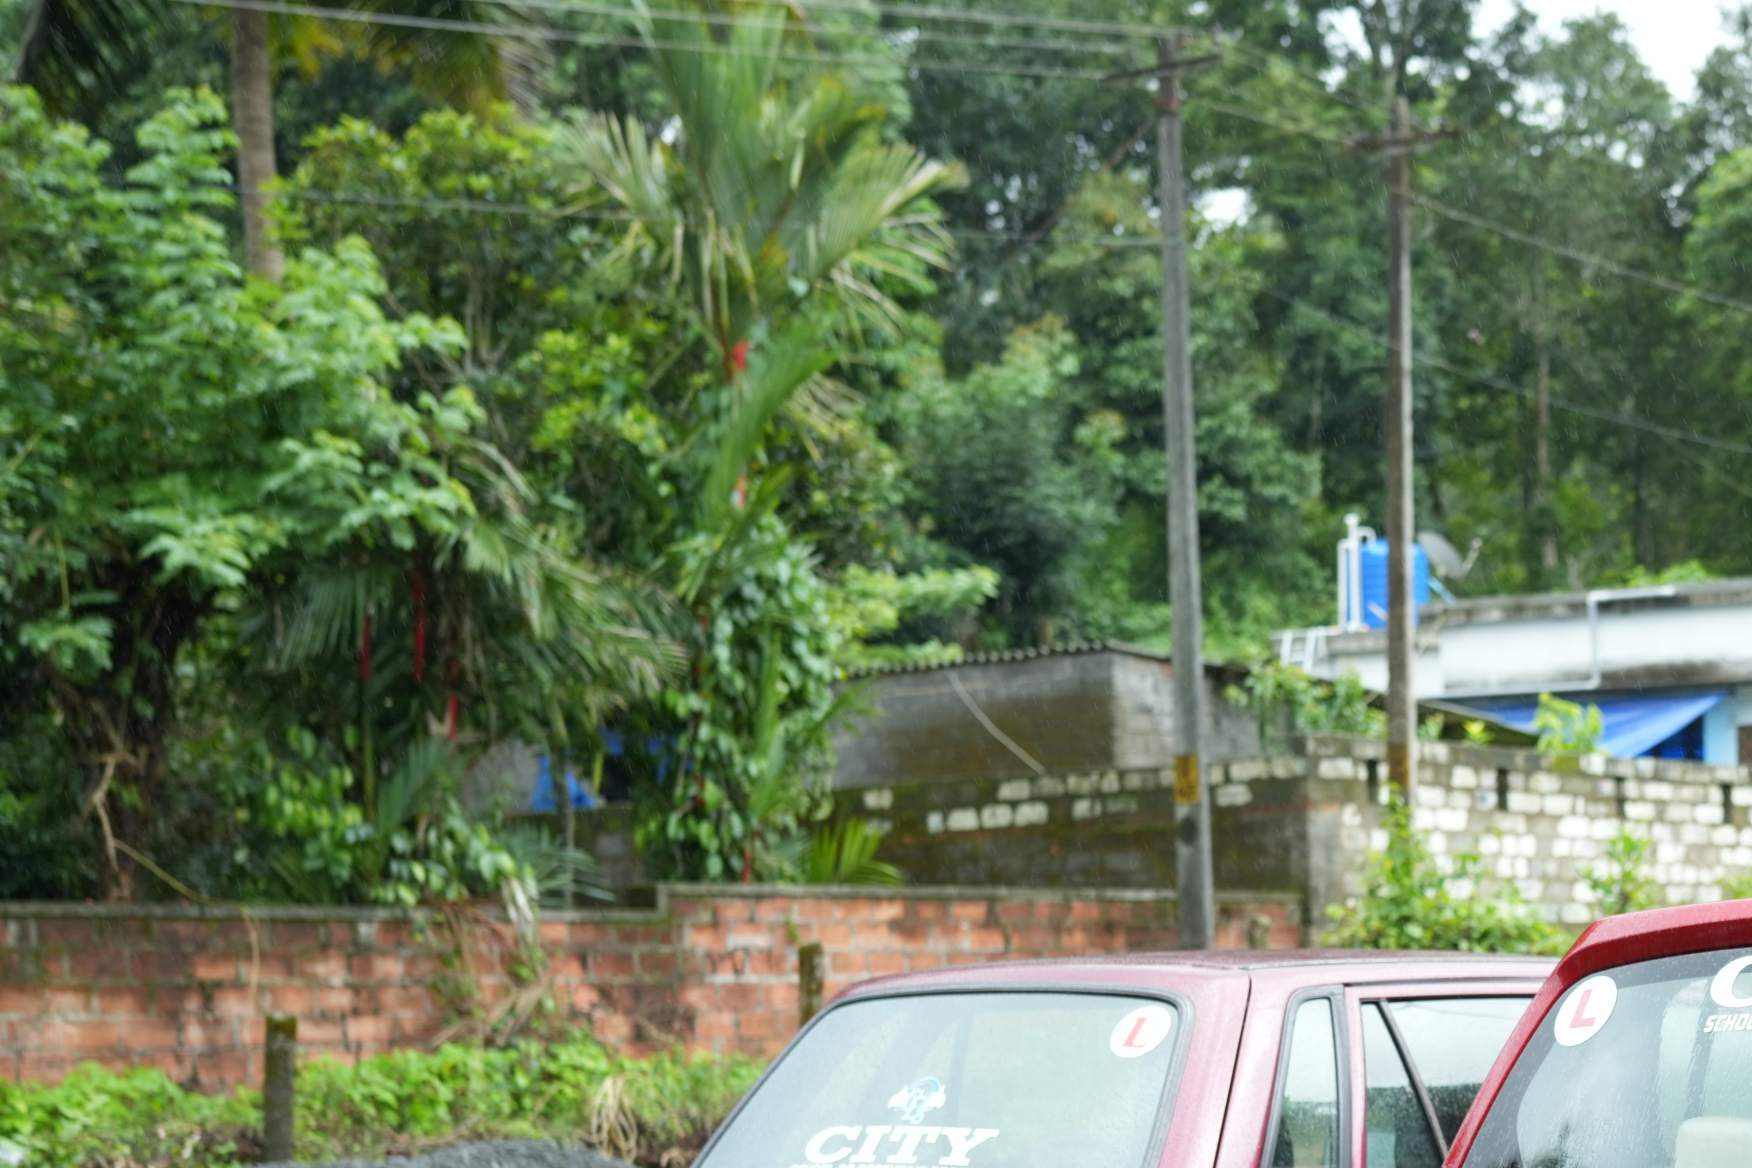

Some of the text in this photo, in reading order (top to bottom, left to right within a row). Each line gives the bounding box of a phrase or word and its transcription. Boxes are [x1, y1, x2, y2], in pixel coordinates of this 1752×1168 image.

[1568, 988, 1596, 1029] L
[1122, 1017, 1146, 1048] L
[804, 1124, 1000, 1166] CITY
